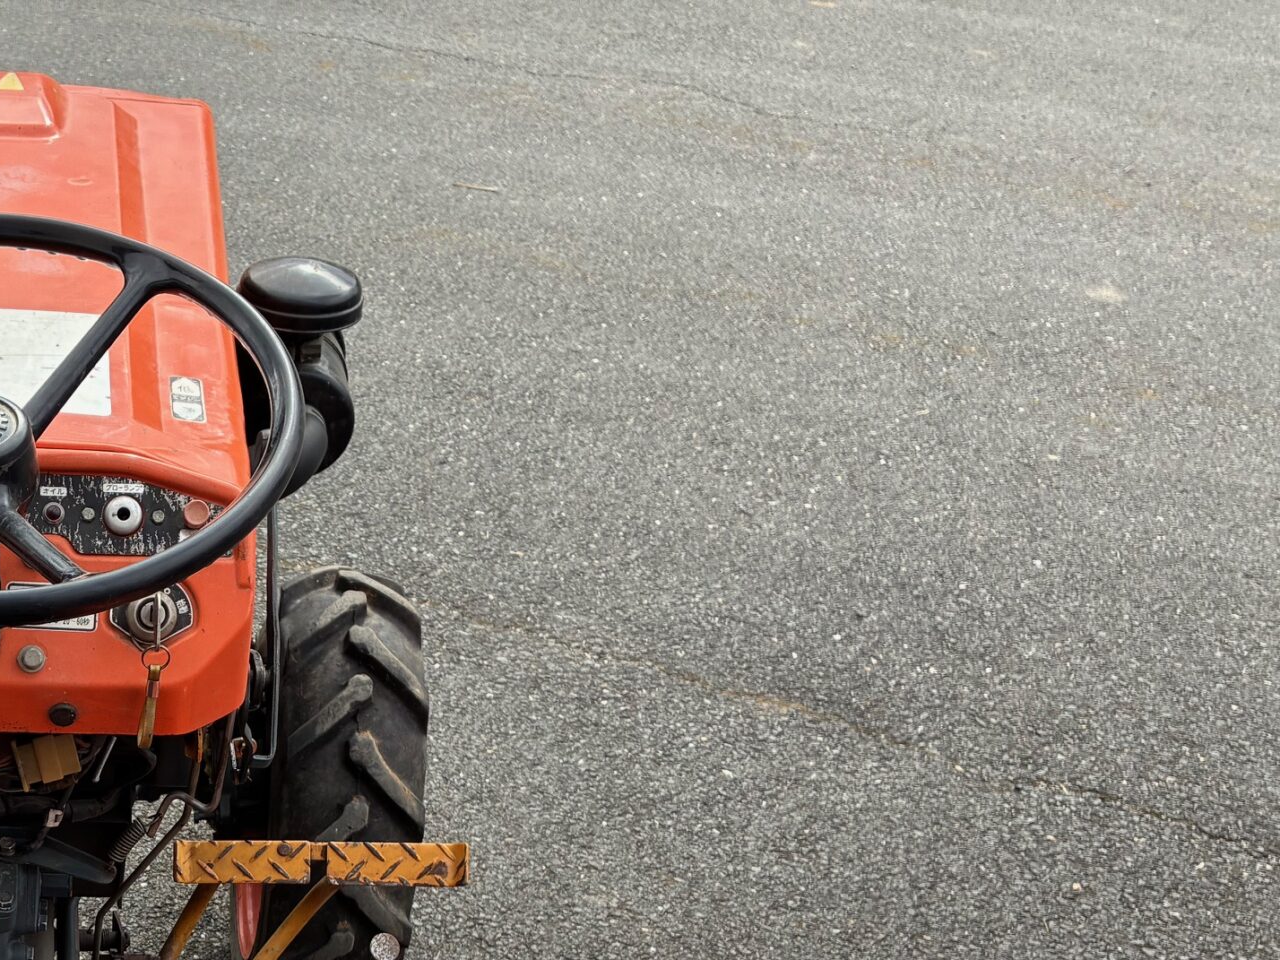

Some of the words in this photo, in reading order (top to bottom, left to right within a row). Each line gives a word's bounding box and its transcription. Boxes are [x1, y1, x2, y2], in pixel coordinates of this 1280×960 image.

[42, 487, 65, 496] オイル
[105, 484, 143, 493] グローランプ
